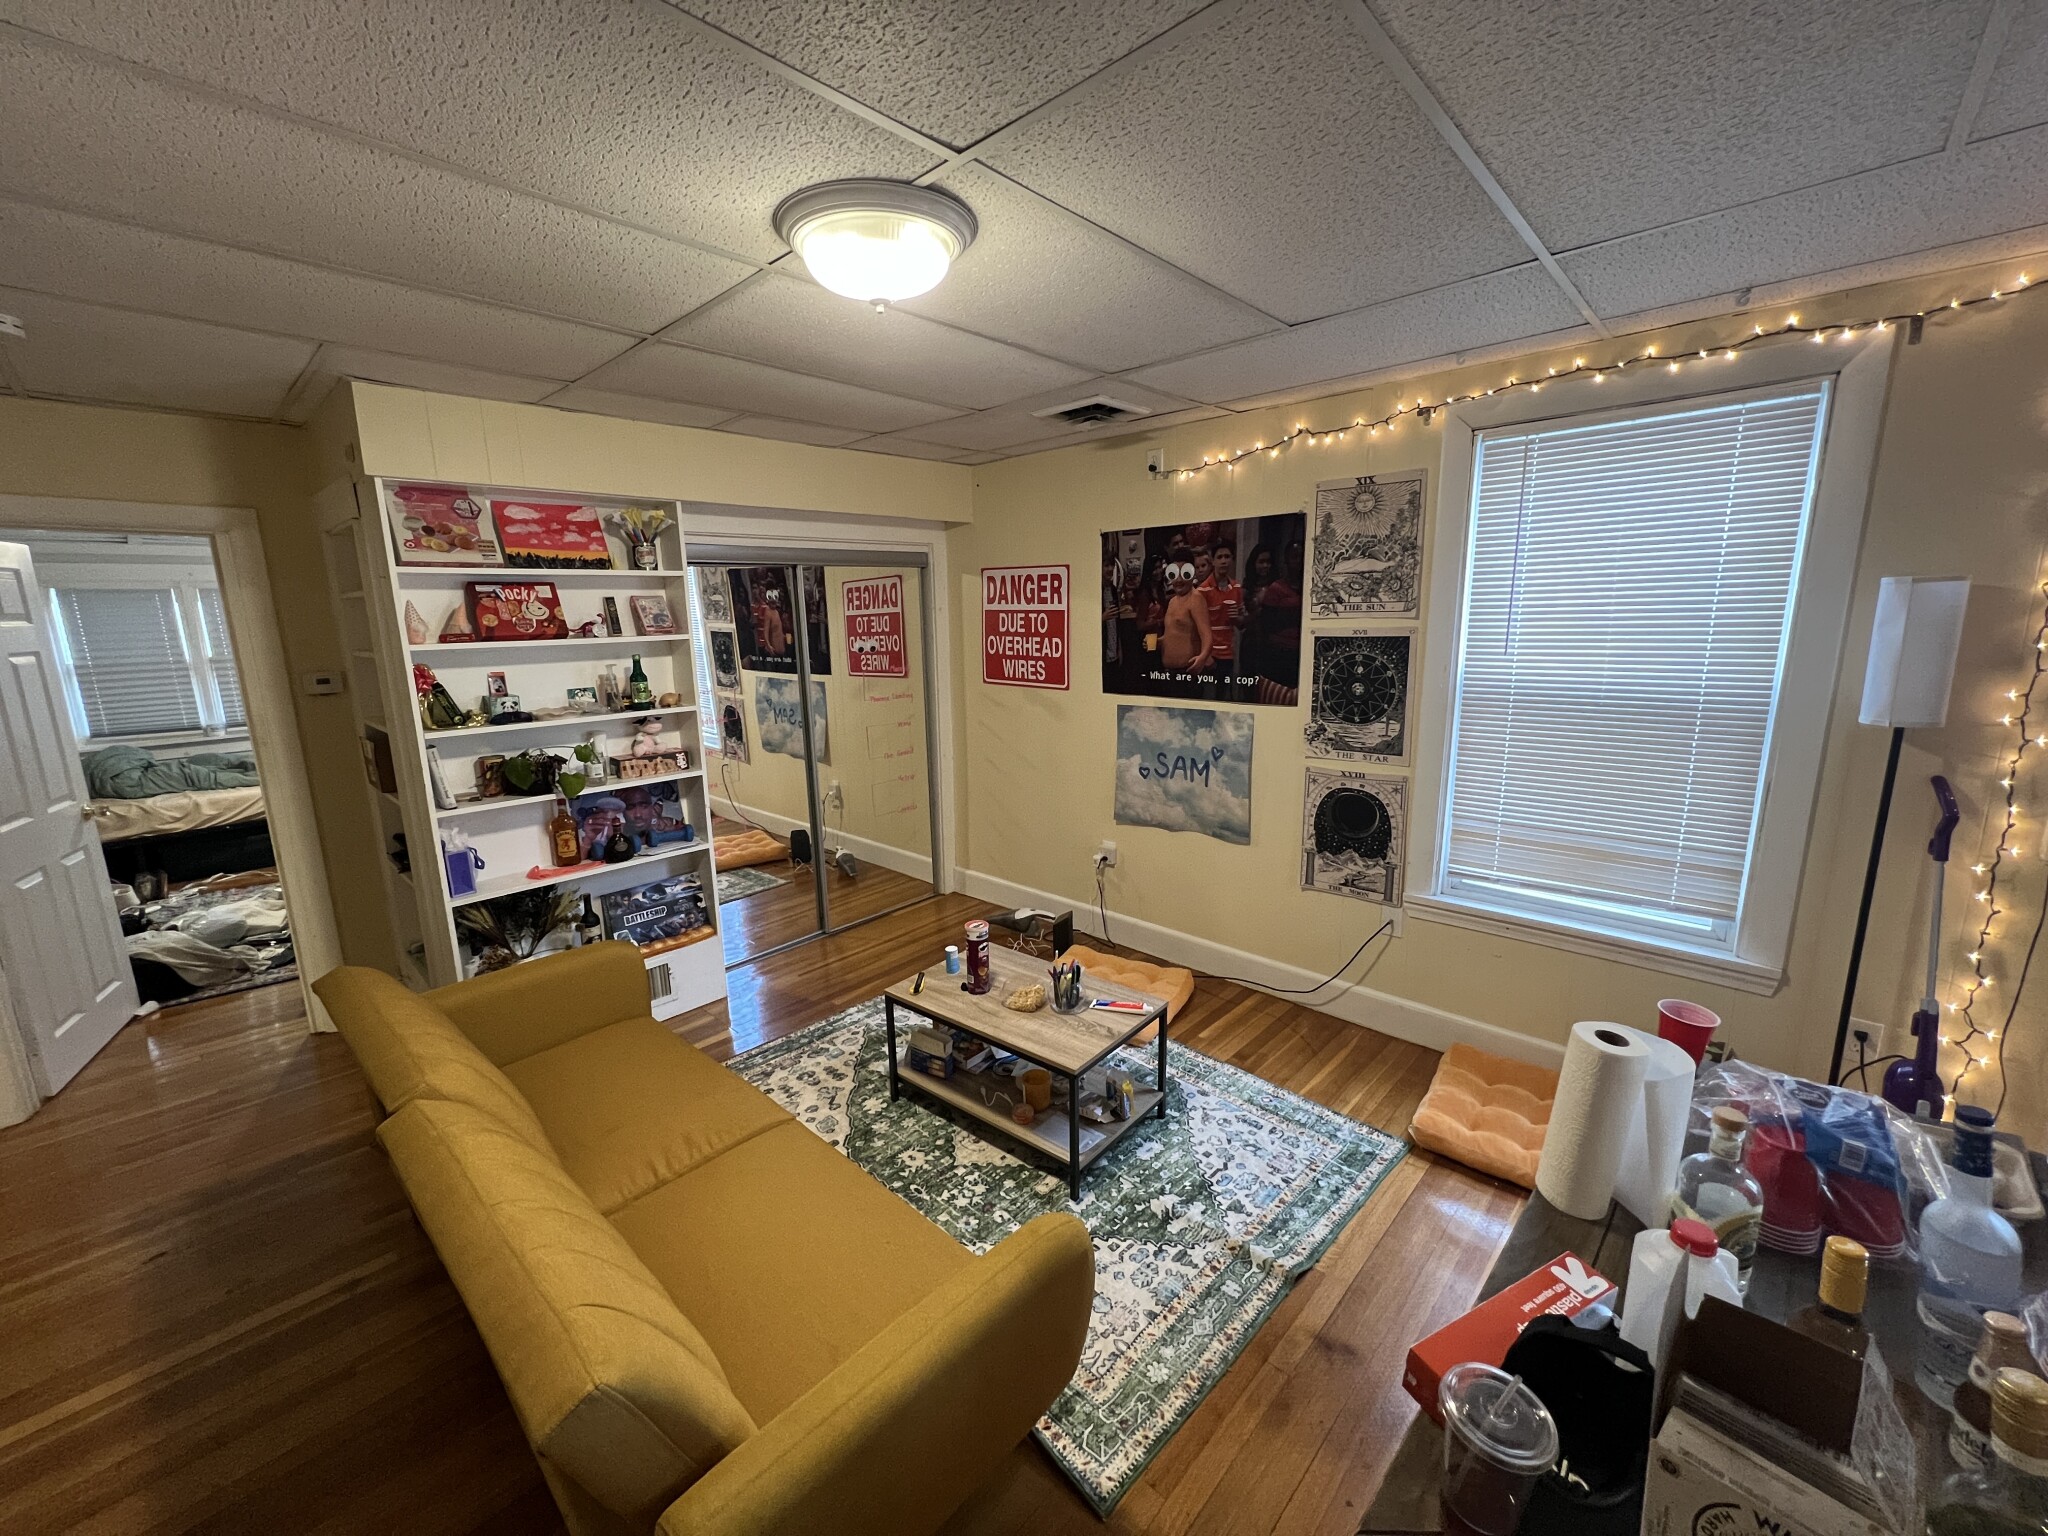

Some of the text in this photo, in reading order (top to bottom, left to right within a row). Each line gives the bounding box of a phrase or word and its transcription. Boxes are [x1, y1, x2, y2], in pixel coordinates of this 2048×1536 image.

[1356, 475, 1376, 486] XIX
[986, 573, 1063, 606] DANGER
[1342, 603, 1387, 612] THE SUN
[999, 612, 1048, 634] DUE TO
[988, 636, 1062, 658] OVERHEAD
[1003, 659, 1046, 681] WIRES
[1150, 671, 1171, 682] What
[1176, 674, 1192, 682] are
[1197, 674, 1219, 684] you,
[1224, 676, 1231, 684] a
[1236, 675, 1260, 686] cop?
[1334, 751, 1389, 763] THE STAR
[1154, 751, 1210, 788] SAM
[1327, 884, 1369, 898] THE MOON
[624, 906, 667, 926] BATTLESHIP
[1535, 1288, 1556, 1305] square
[1520, 1298, 1536, 1313] feet
